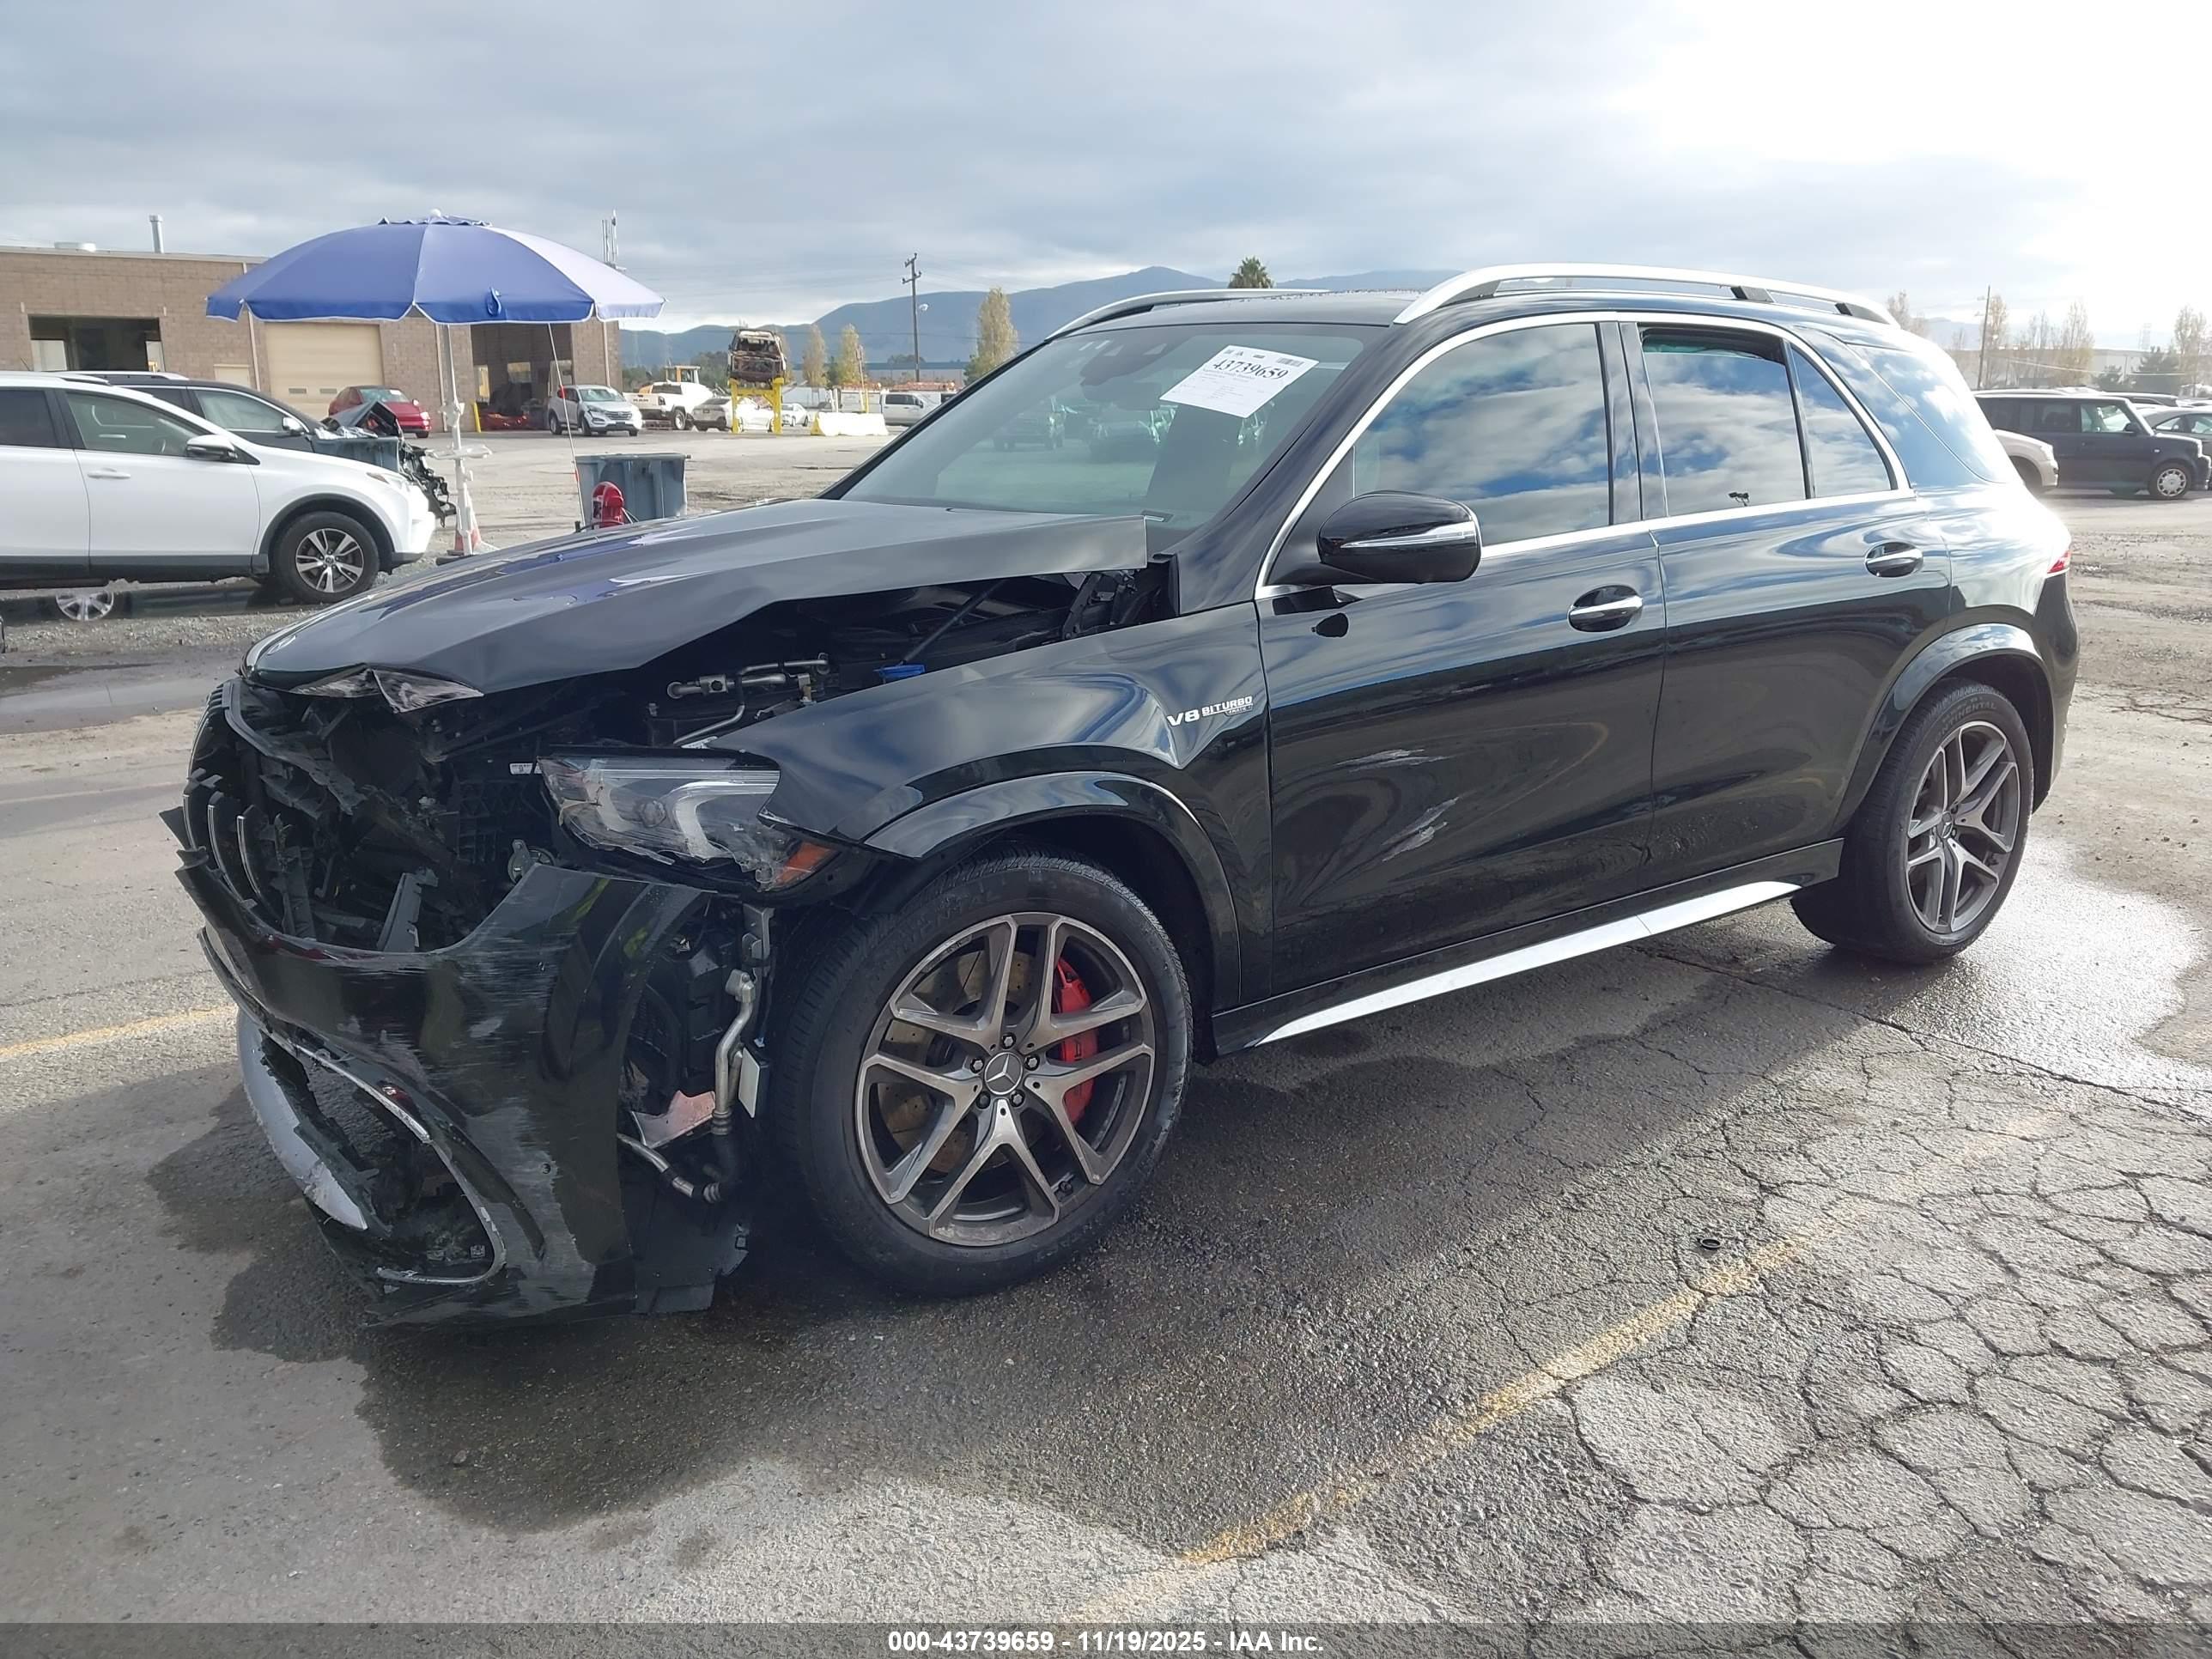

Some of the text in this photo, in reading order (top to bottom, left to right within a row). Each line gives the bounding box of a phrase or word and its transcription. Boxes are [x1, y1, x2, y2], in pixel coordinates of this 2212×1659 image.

[1212, 358, 1289, 380] 43739659
[1167, 696, 1253, 726] V8 BITURBO
